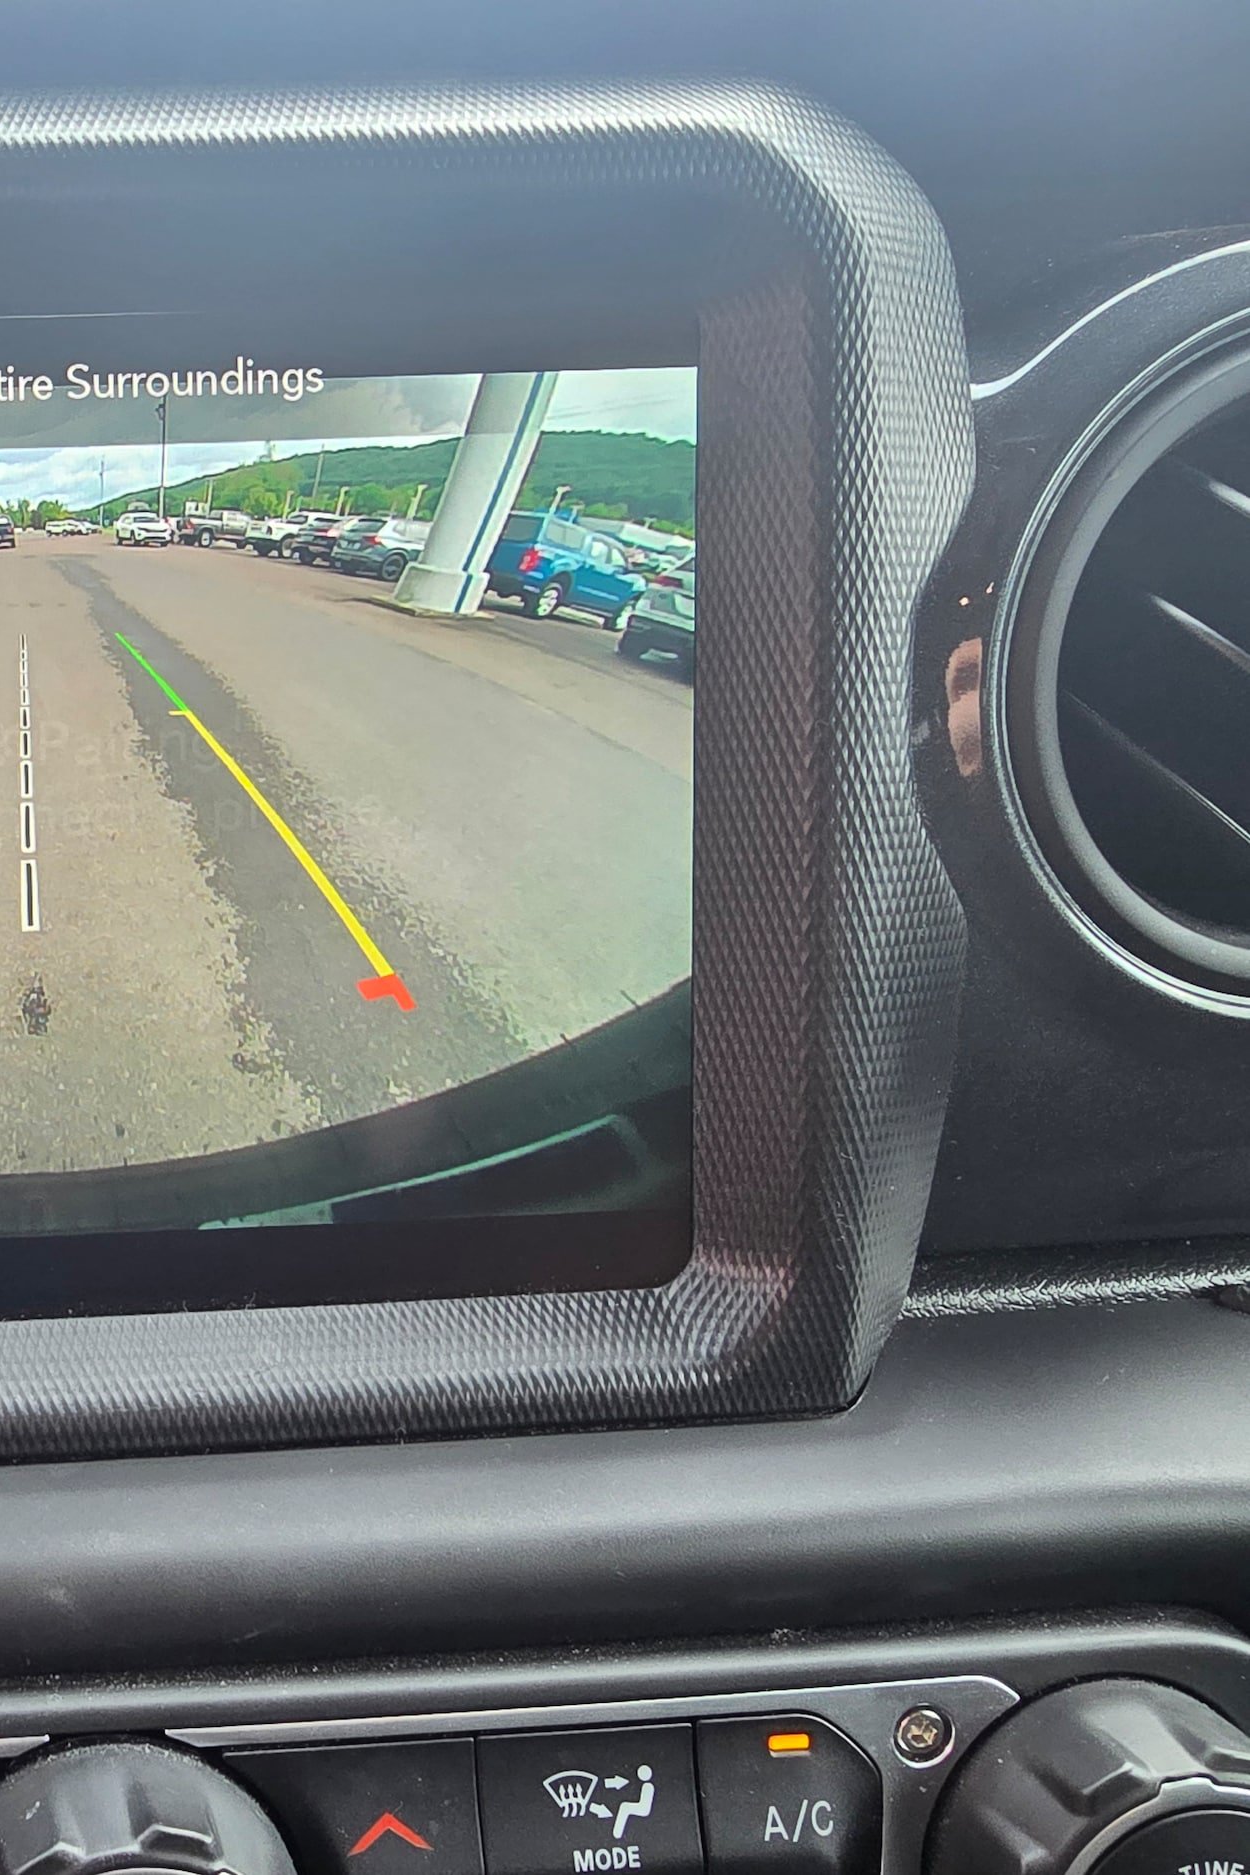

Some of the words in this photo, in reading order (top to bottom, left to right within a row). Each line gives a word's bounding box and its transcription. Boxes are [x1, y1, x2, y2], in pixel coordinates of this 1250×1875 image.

[67, 356, 324, 402] Surroundings
[764, 1799, 833, 1842] A/C
[573, 1845, 641, 1872] MODE
